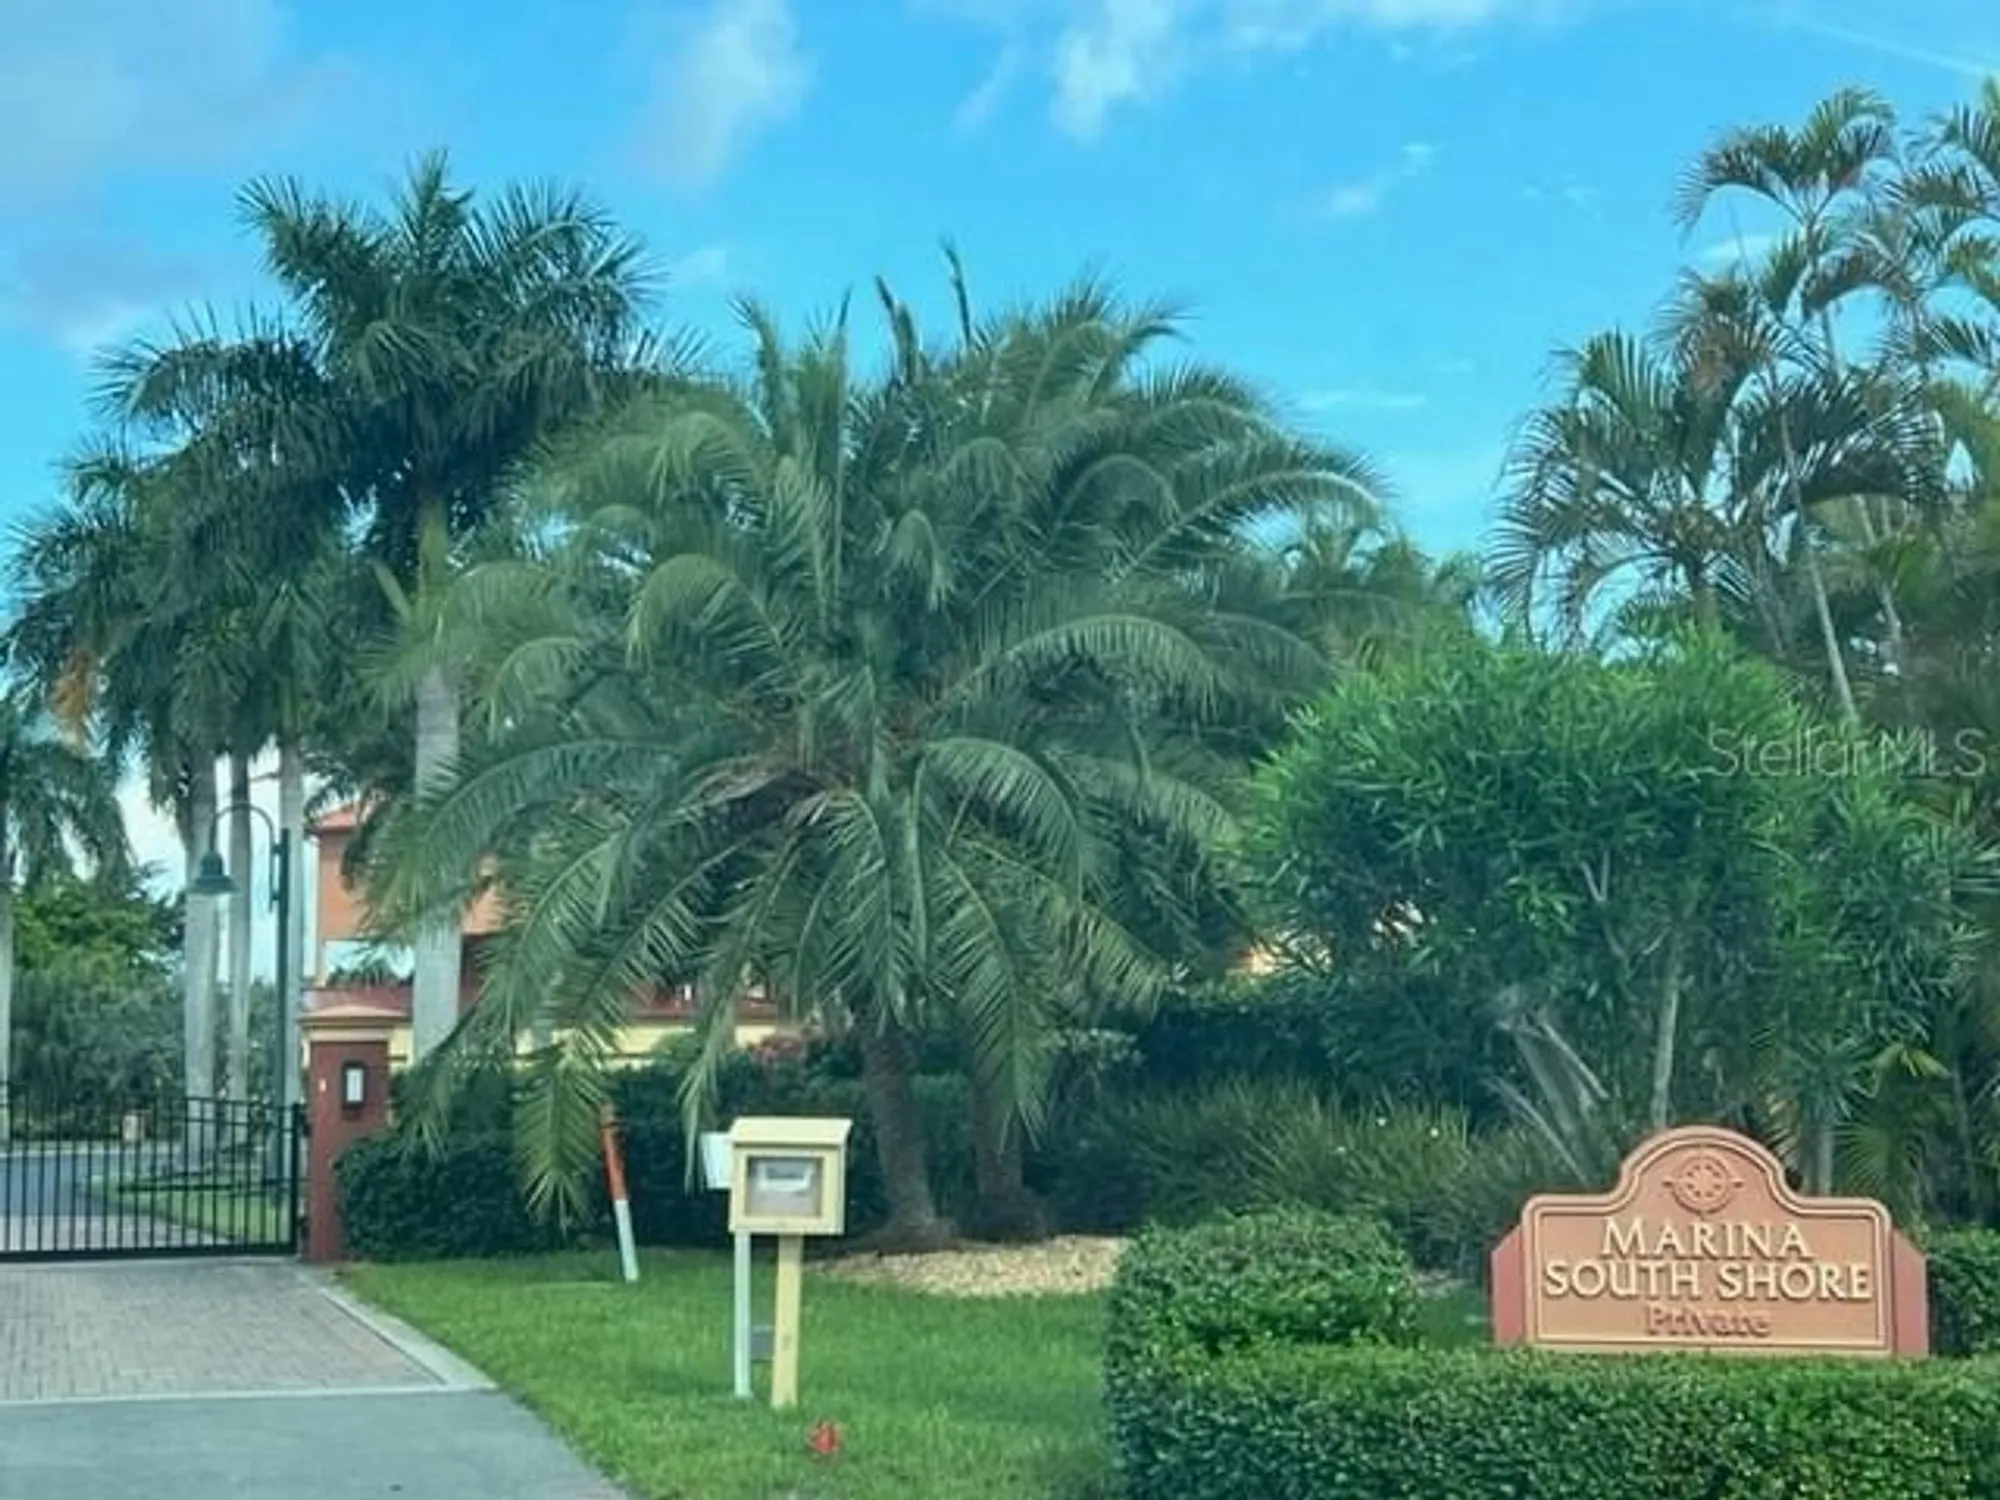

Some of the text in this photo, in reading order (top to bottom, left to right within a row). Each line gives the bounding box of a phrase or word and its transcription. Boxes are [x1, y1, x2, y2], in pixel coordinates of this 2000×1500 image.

[1601, 1218, 1812, 1259] MARINA
[1545, 1259, 1874, 1301] SOUTH SHORE
[1646, 1302, 1772, 1338] Private
